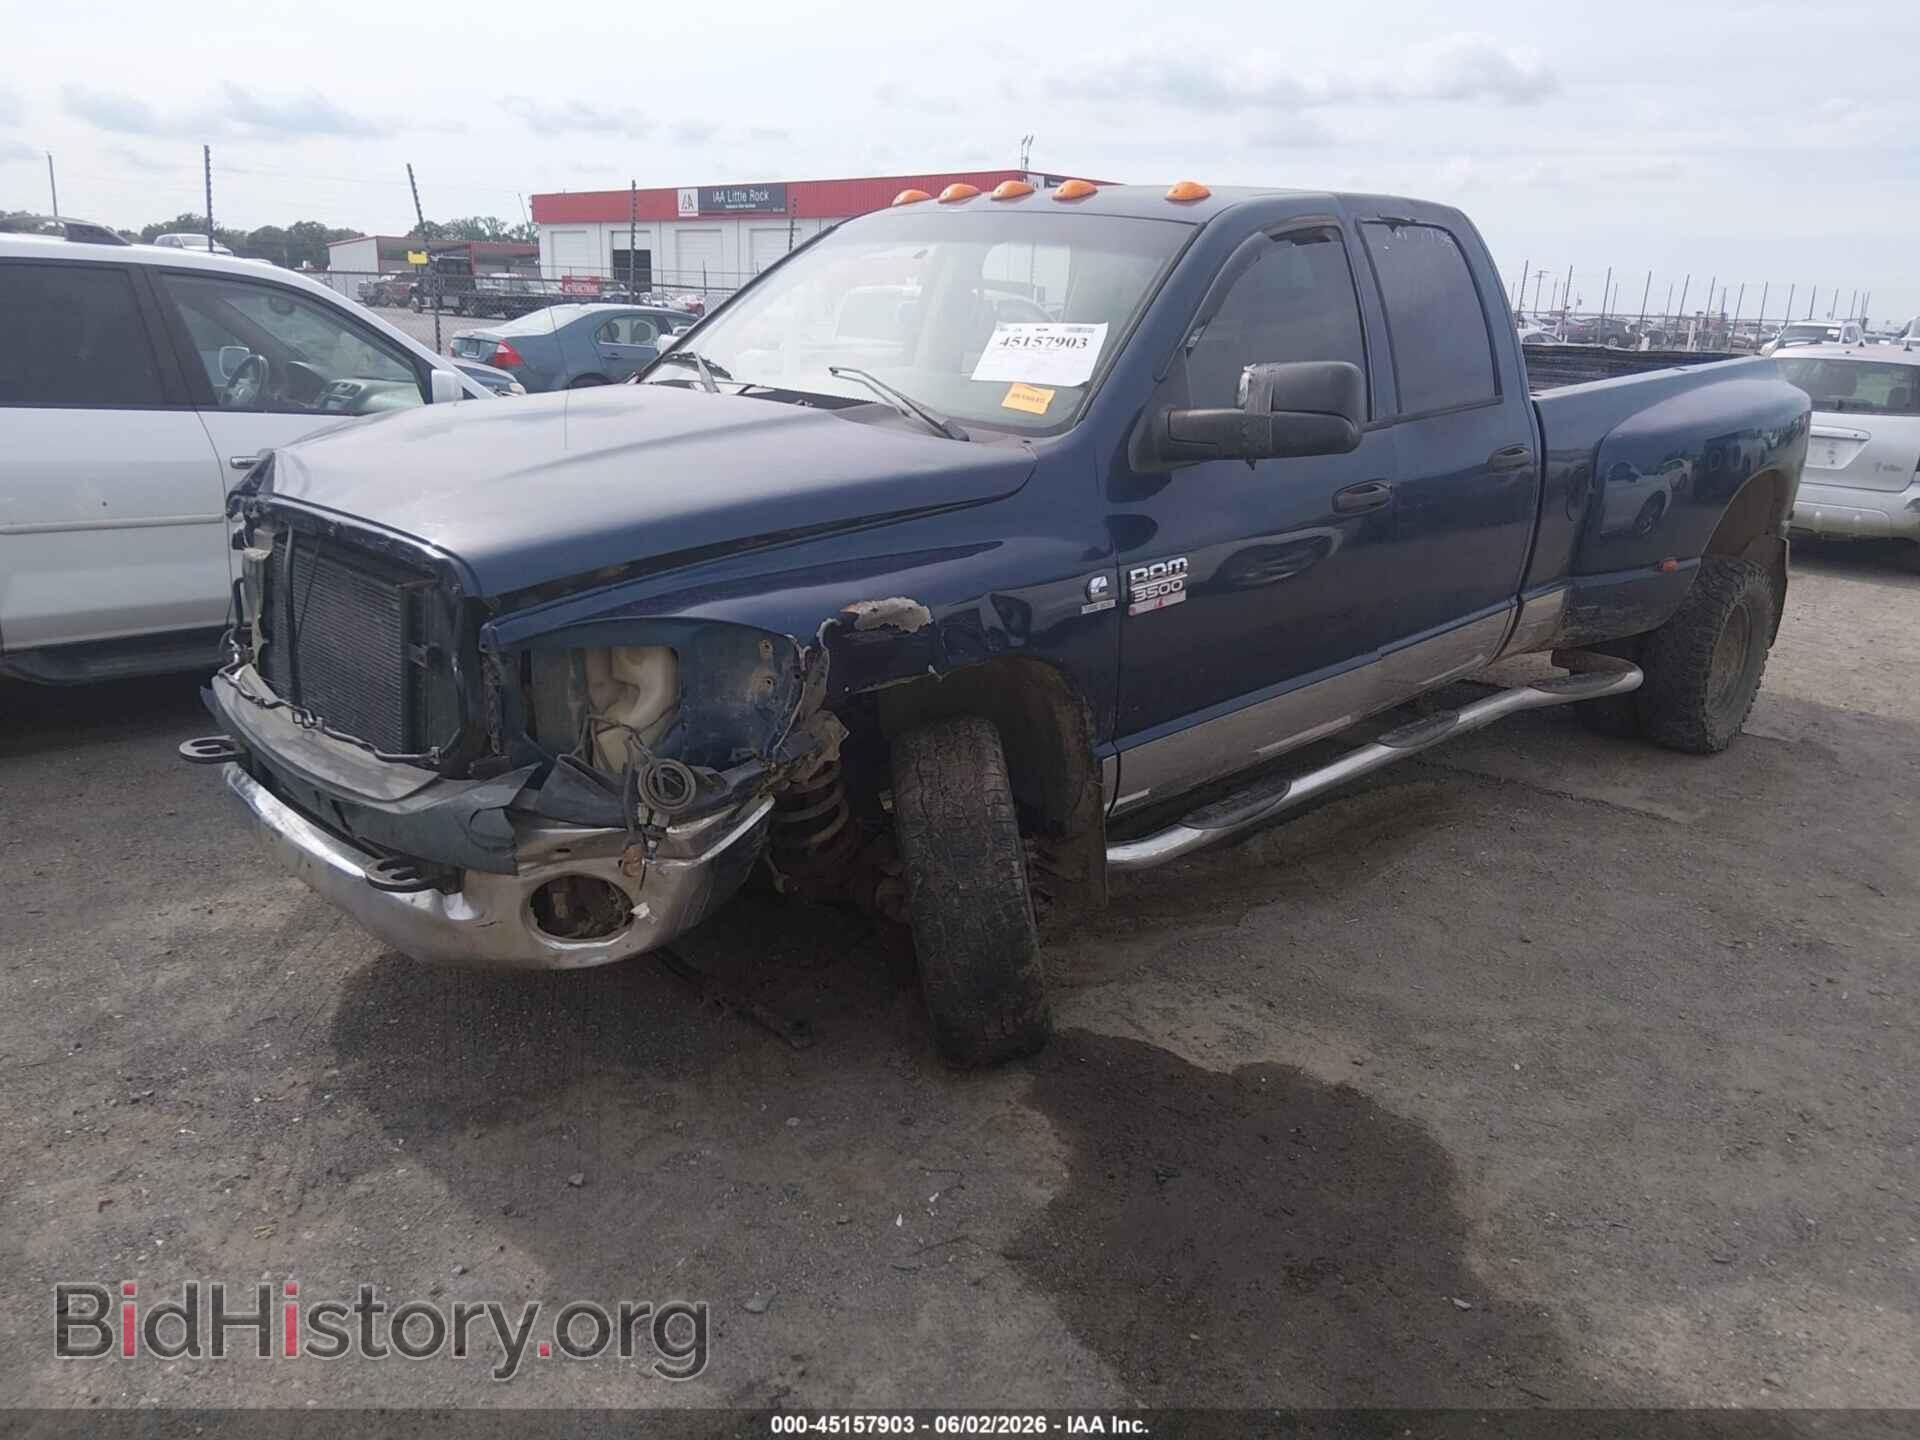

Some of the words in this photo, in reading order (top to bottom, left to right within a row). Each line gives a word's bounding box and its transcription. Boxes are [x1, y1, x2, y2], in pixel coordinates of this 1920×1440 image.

[727, 189, 747, 202] Little
[749, 187, 770, 201] Rock
[1000, 336, 1088, 348] 45157903
[1130, 557, 1188, 583] RAM
[1134, 579, 1184, 602] 3500
